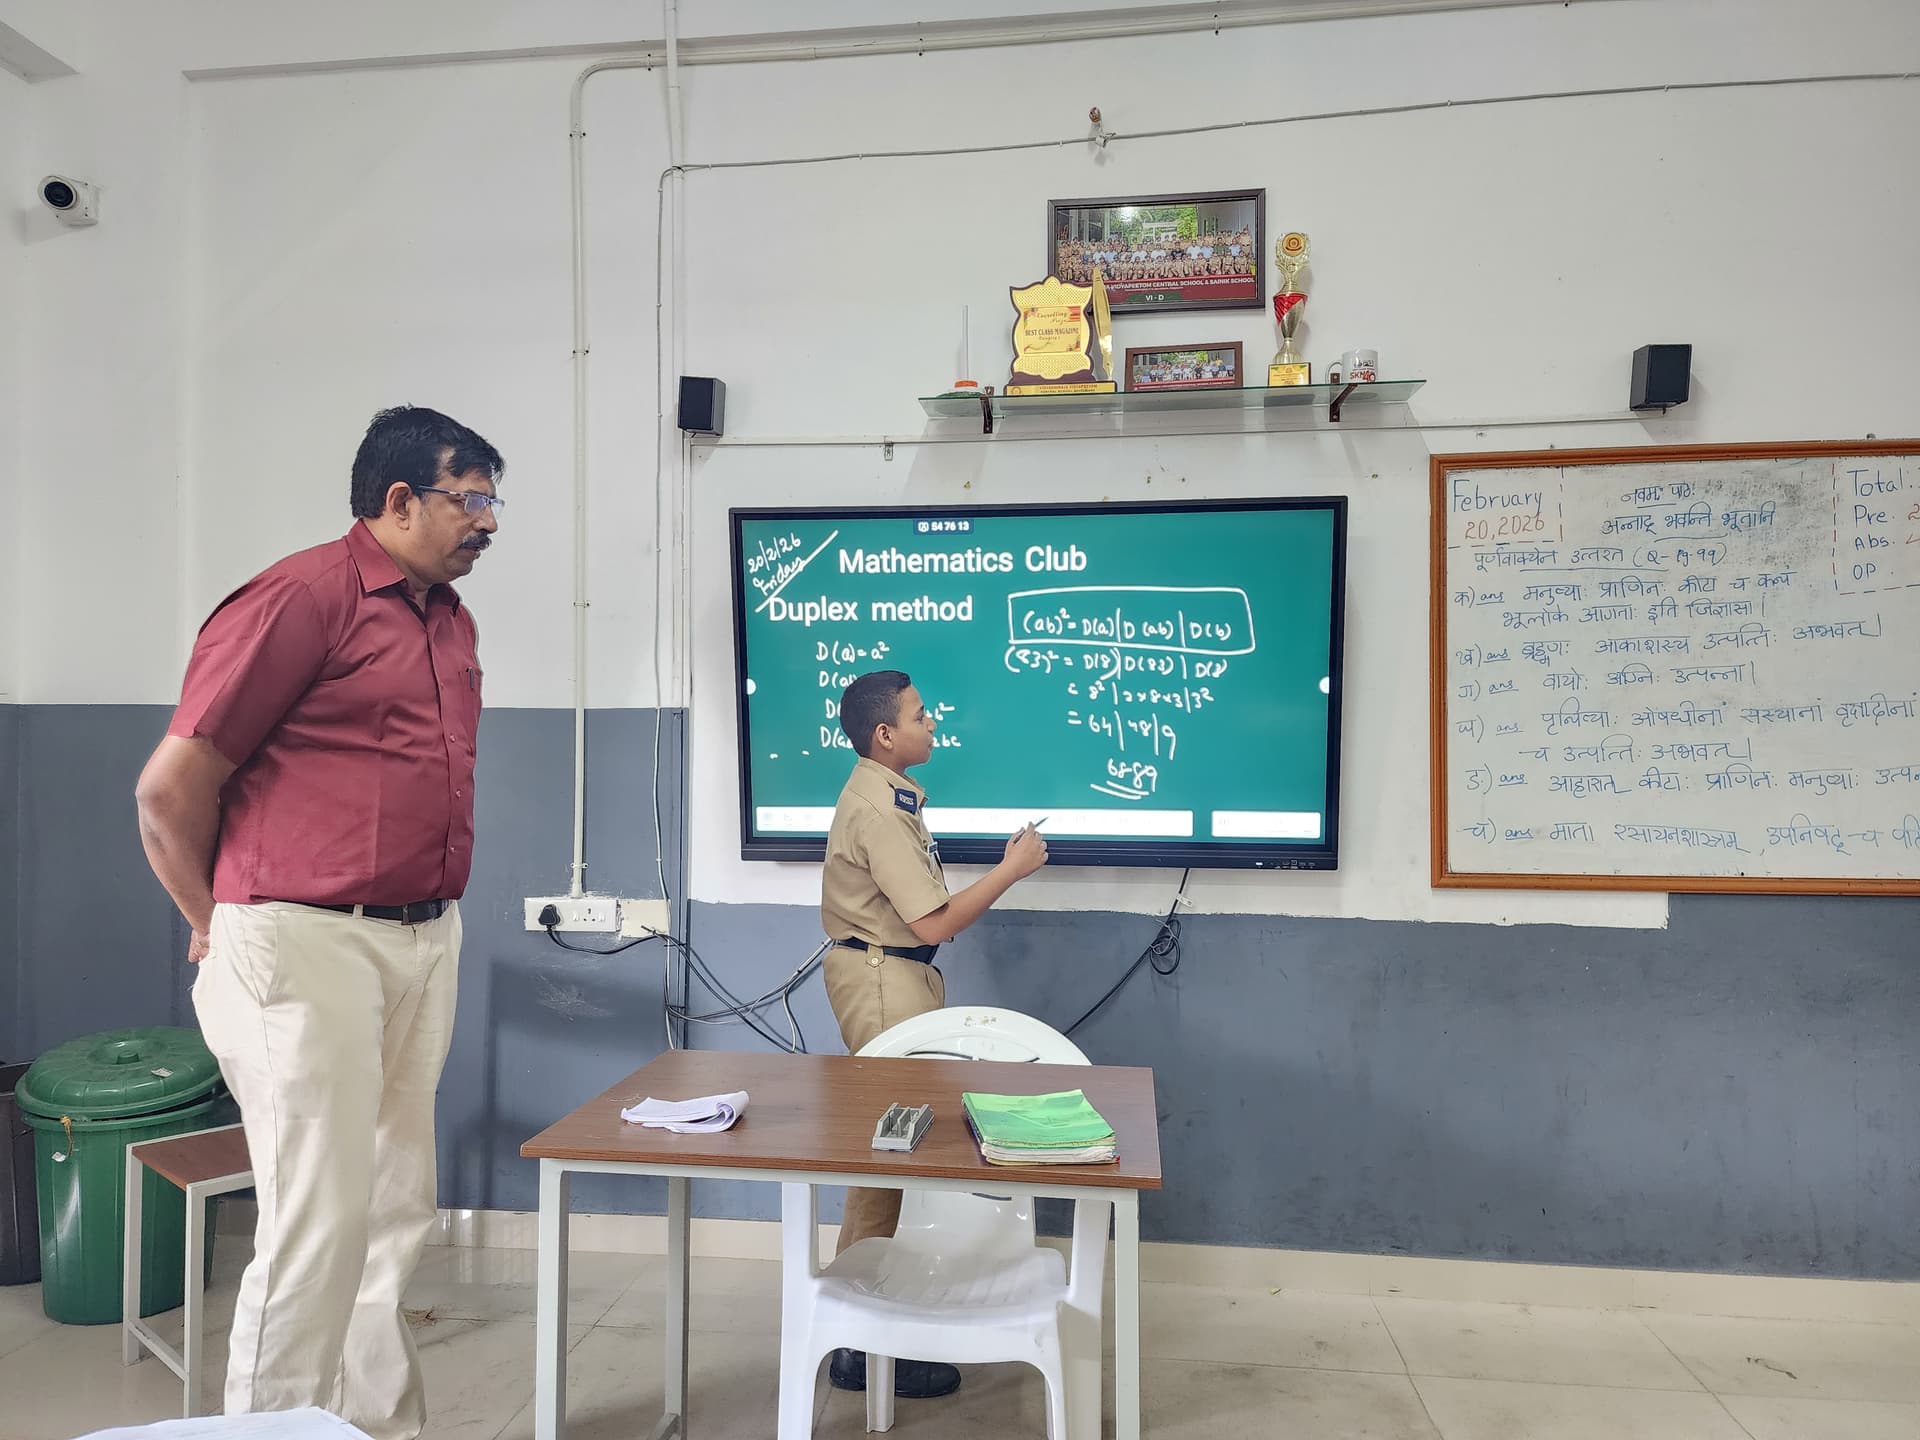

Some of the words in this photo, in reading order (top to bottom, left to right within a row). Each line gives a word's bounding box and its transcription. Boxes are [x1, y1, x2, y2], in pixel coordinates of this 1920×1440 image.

[1453, 479, 1542, 518] February
[839, 547, 1014, 574] Mathematics
[1025, 544, 1087, 572] Club
[1729, 577, 1751, 591] च
[769, 595, 858, 627] Duplex
[871, 594, 973, 621] method
[1549, 822, 1594, 842] माता
